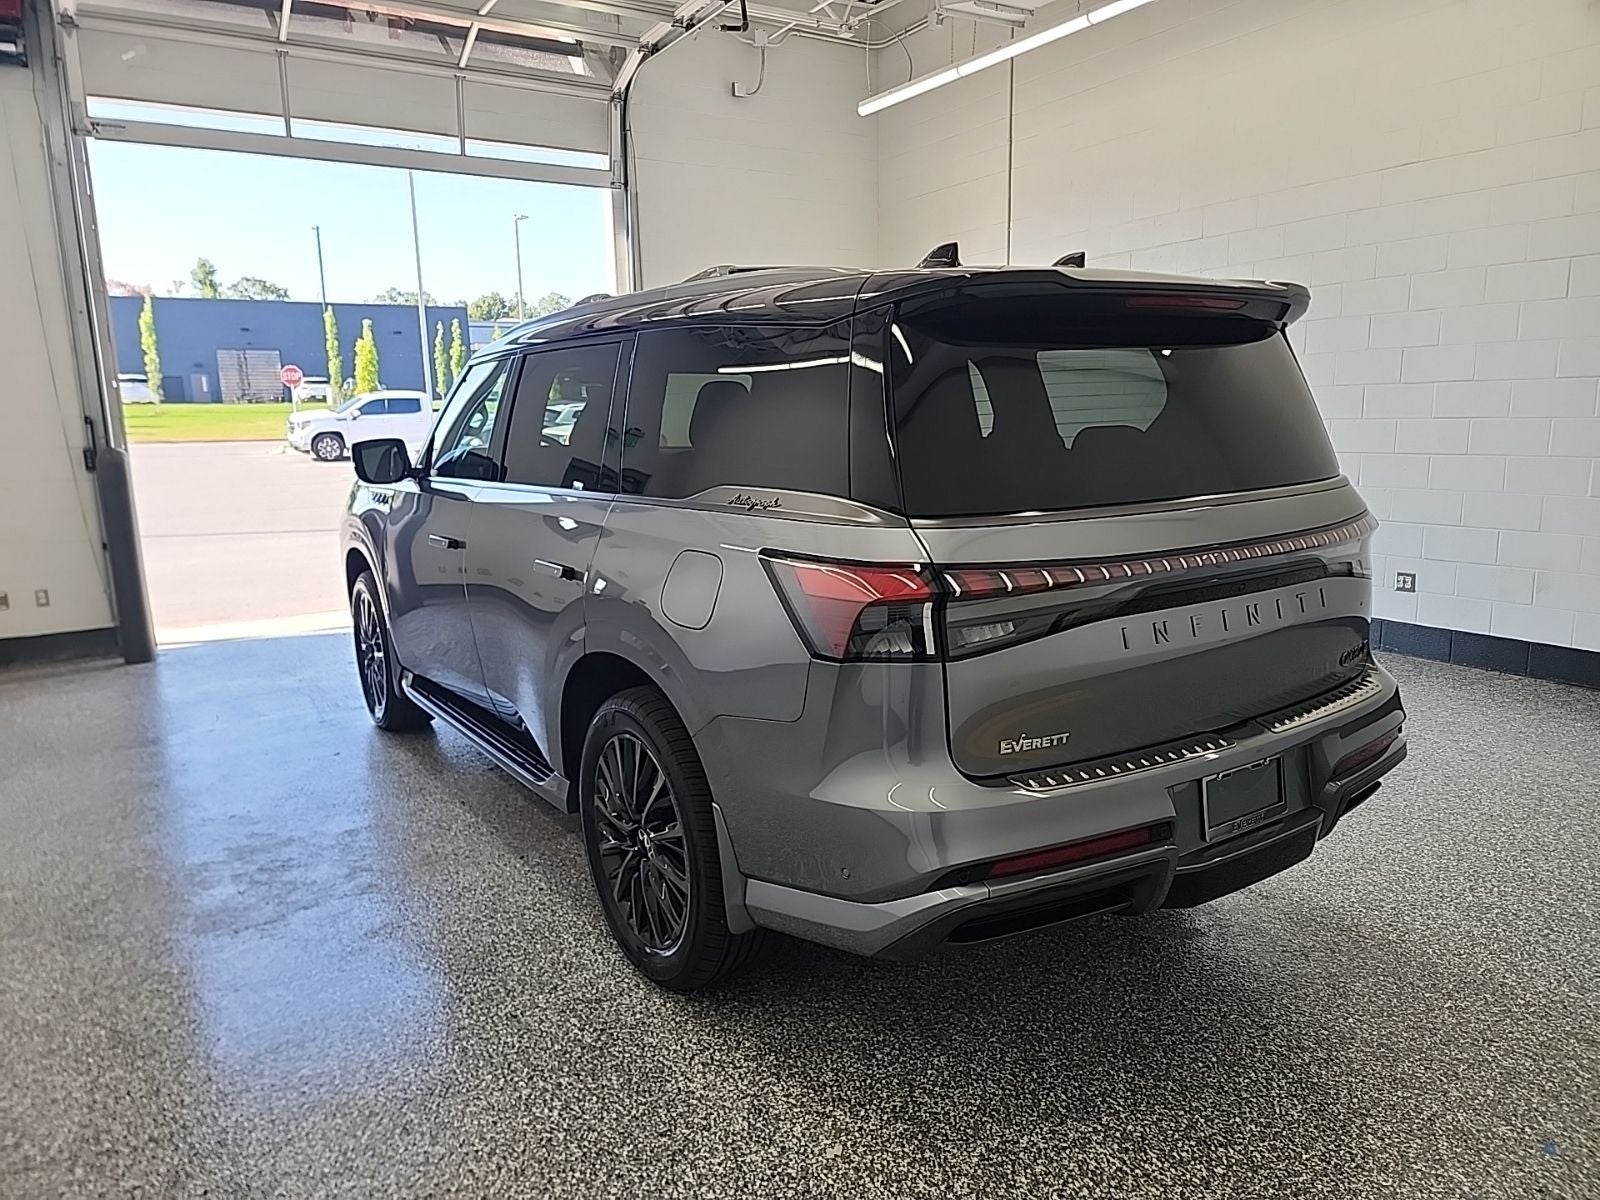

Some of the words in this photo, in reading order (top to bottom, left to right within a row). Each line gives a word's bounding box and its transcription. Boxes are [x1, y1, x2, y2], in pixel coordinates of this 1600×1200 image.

[282, 370, 301, 381] STOP
[1121, 587, 1327, 650] INFINITI
[1000, 732, 1070, 755] EVERETT
